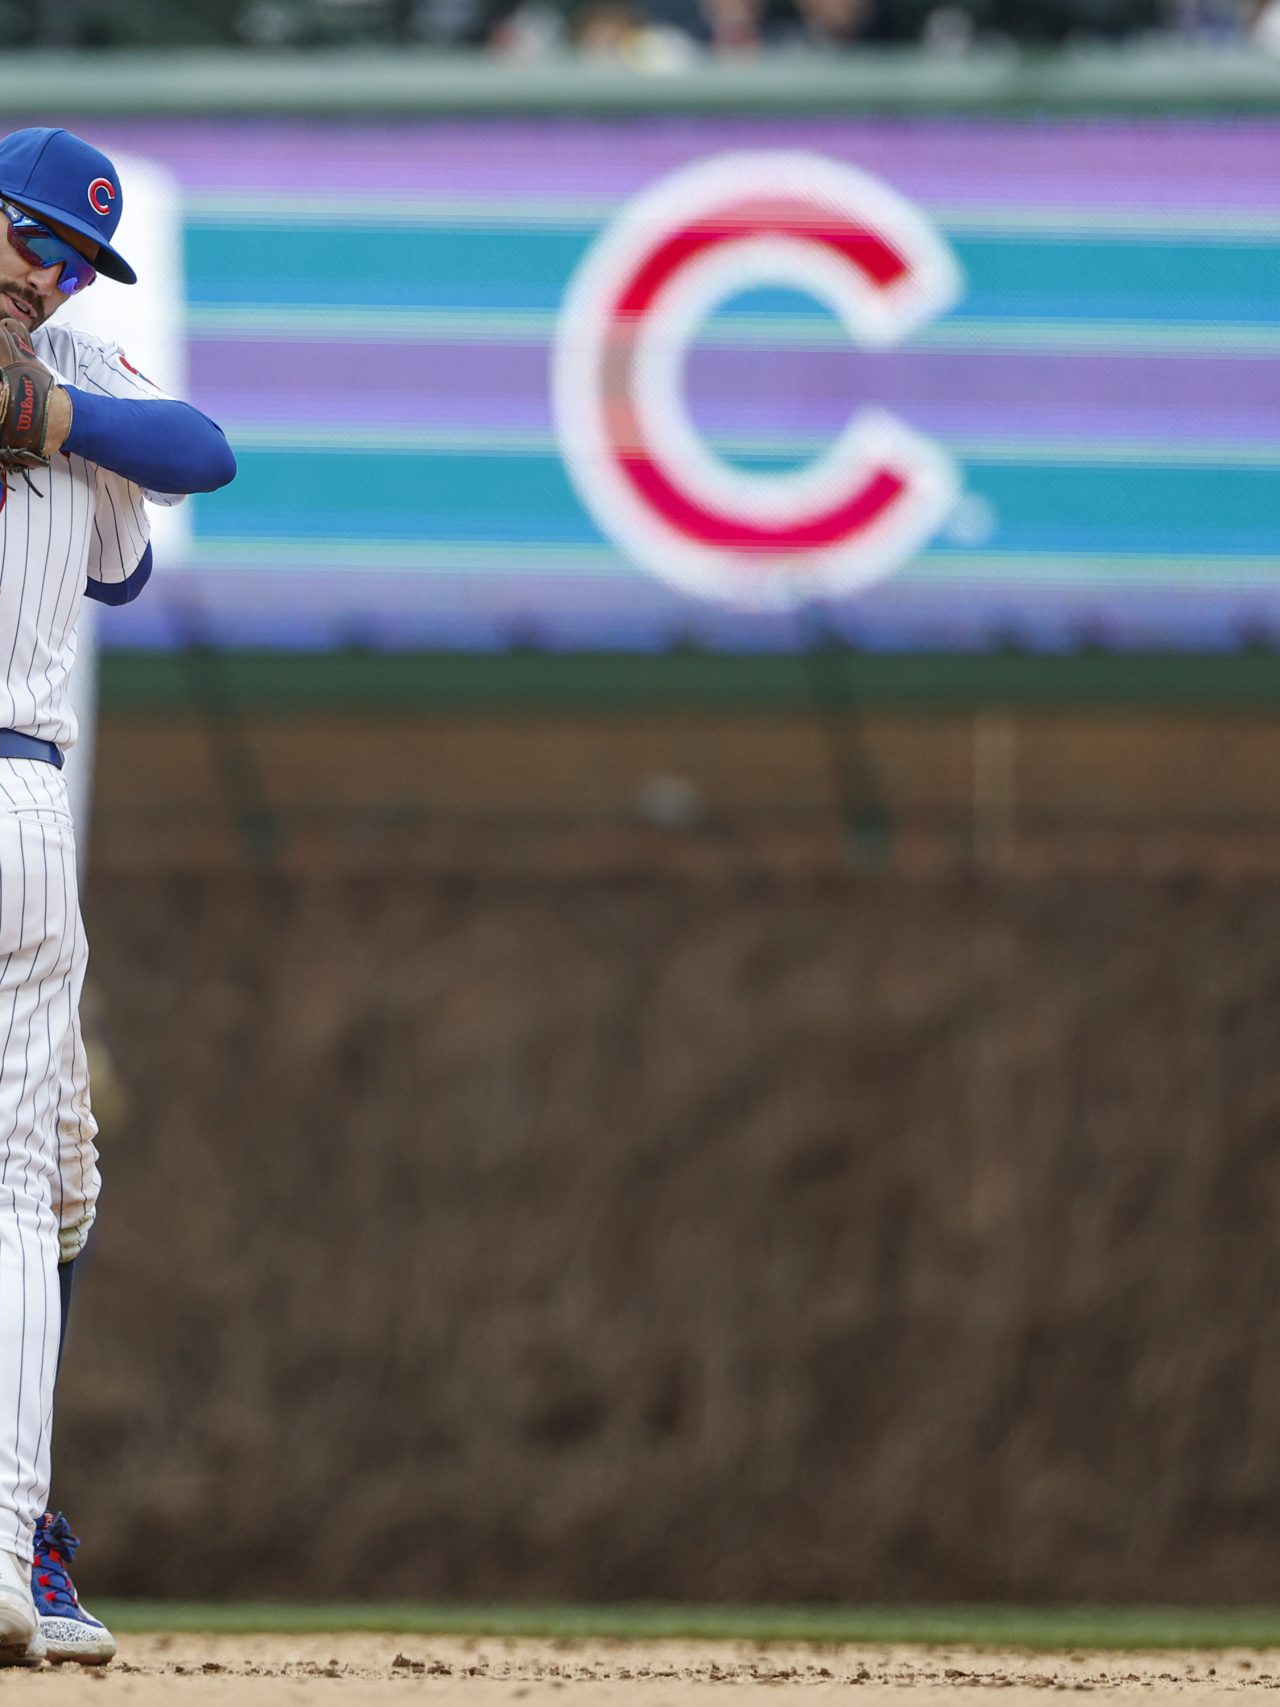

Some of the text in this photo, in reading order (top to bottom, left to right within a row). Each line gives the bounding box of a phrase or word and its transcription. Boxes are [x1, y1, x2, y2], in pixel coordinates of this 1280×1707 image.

[87, 177, 116, 216] C
[16, 379, 34, 431] Wilson
[552, 154, 963, 608] C
